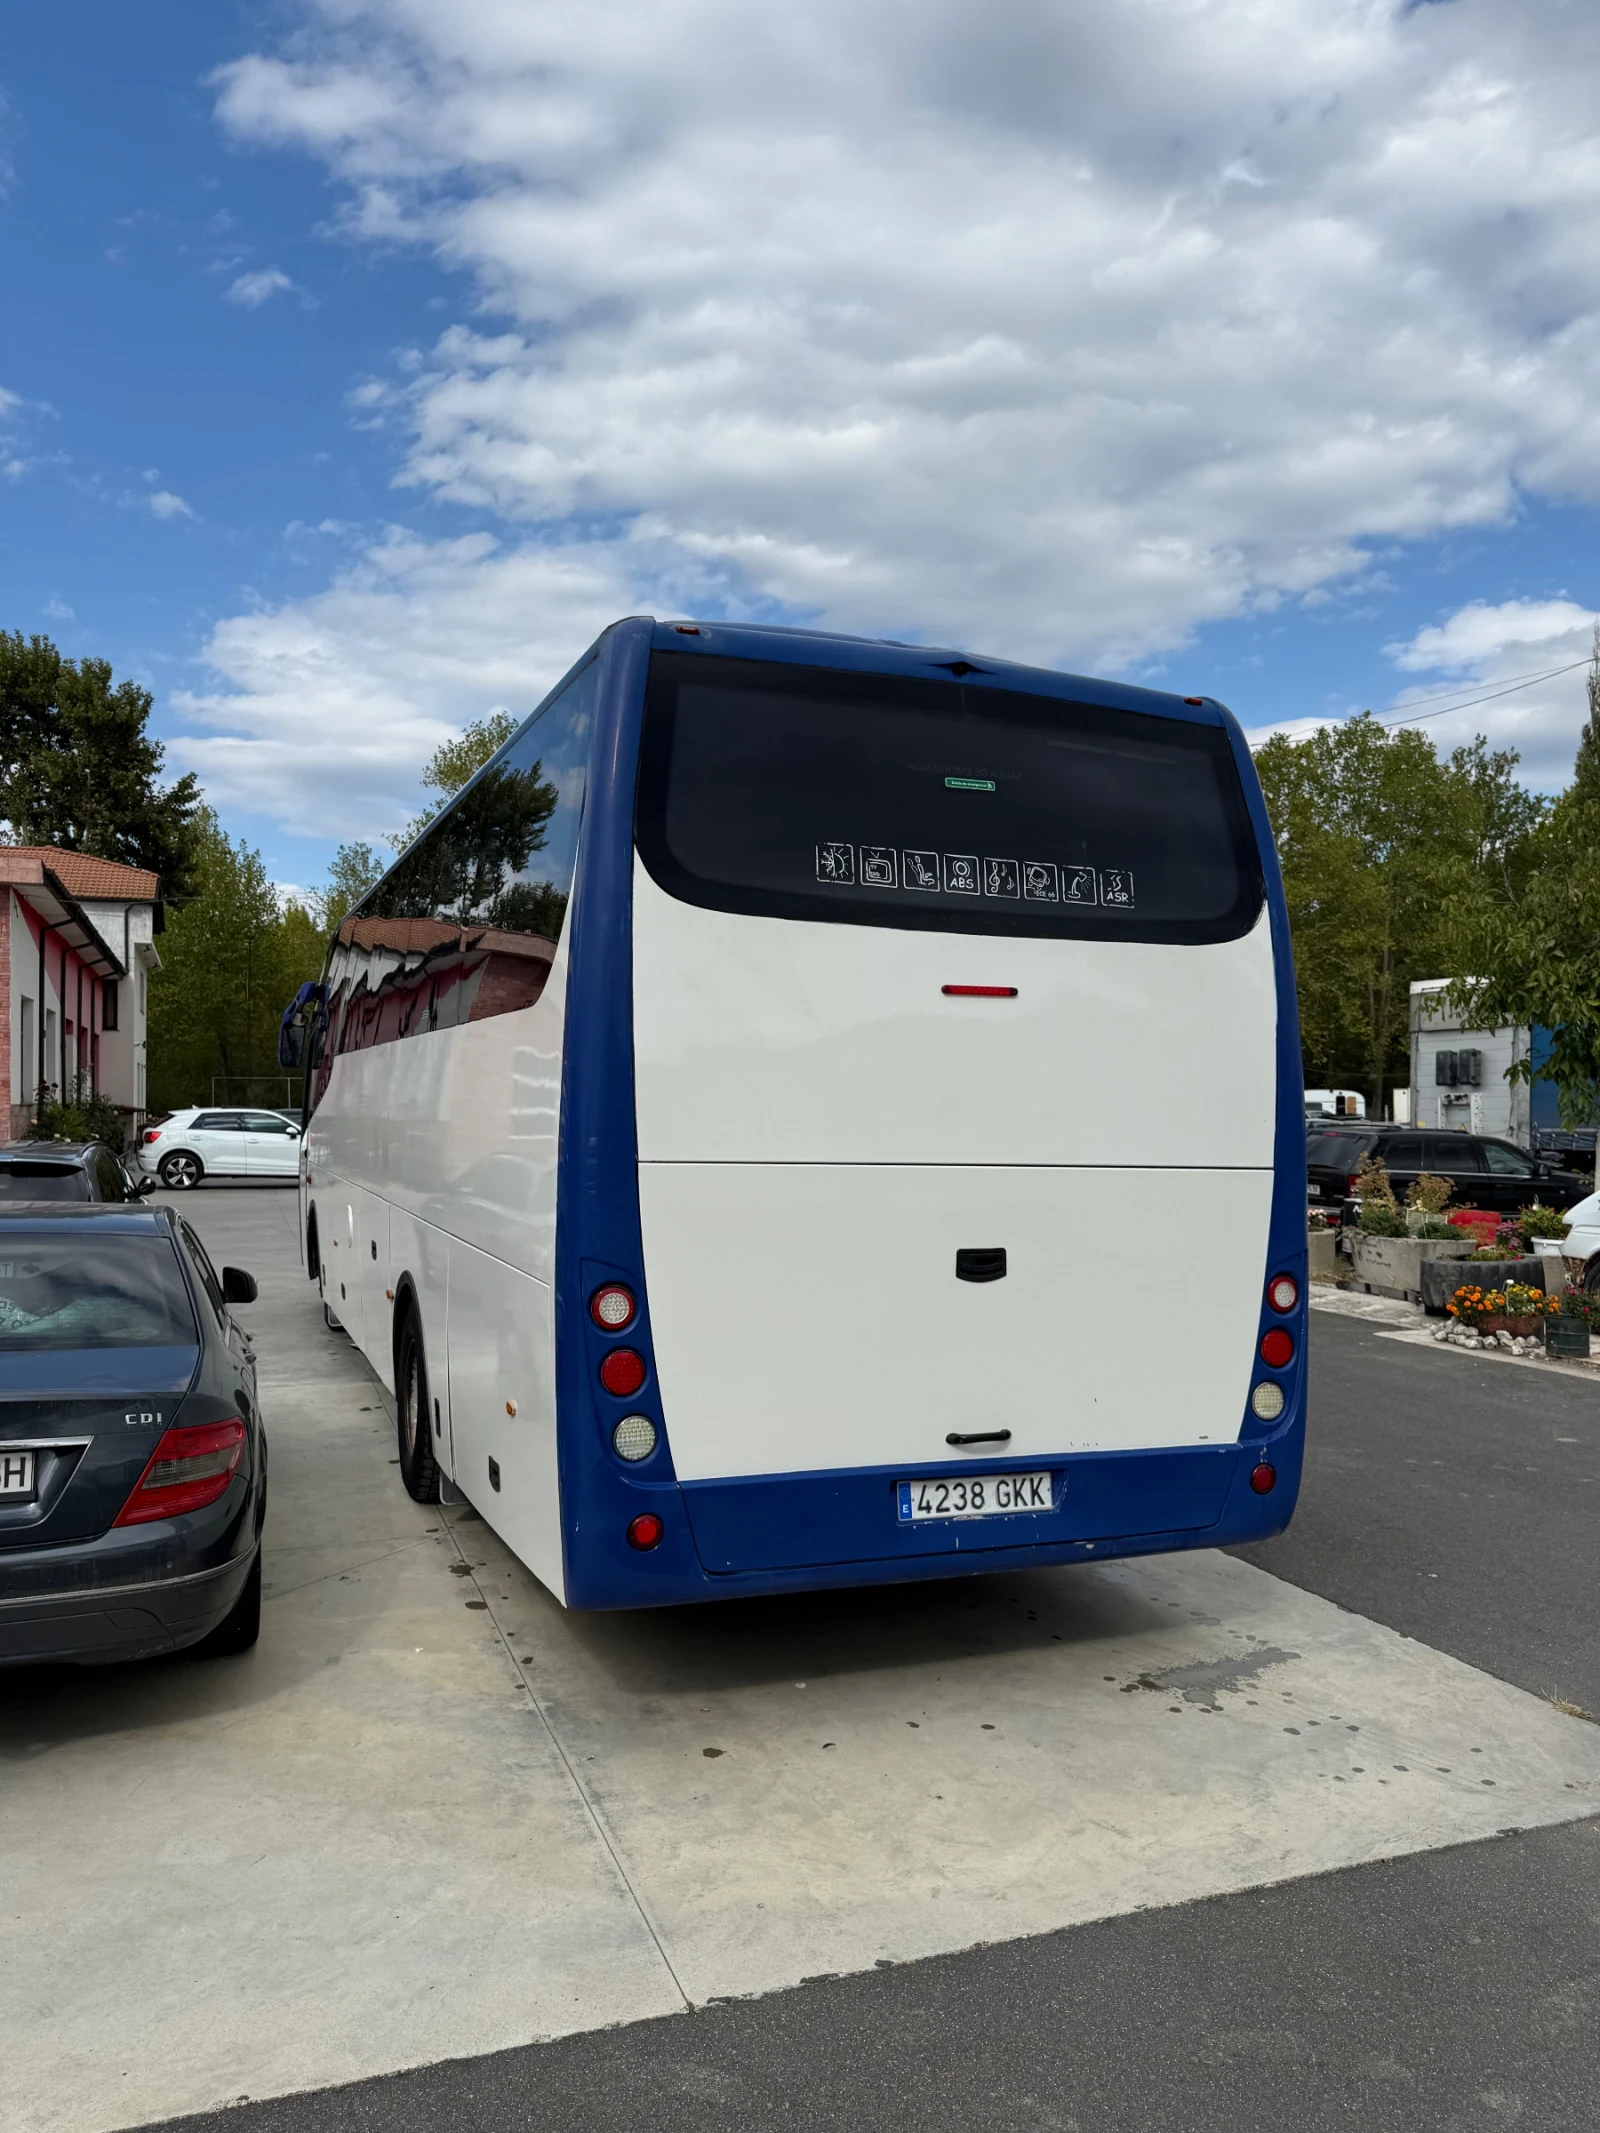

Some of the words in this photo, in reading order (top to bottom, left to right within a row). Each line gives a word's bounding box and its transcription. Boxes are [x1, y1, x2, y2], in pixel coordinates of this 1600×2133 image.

[950, 877, 974, 889] ABS
[1107, 891, 1129, 903] ASR
[125, 1412, 162, 1425] CDI
[917, 1481, 985, 1514] 4238
[996, 1477, 1046, 1508] GKK
[902, 1504, 909, 1513] E
